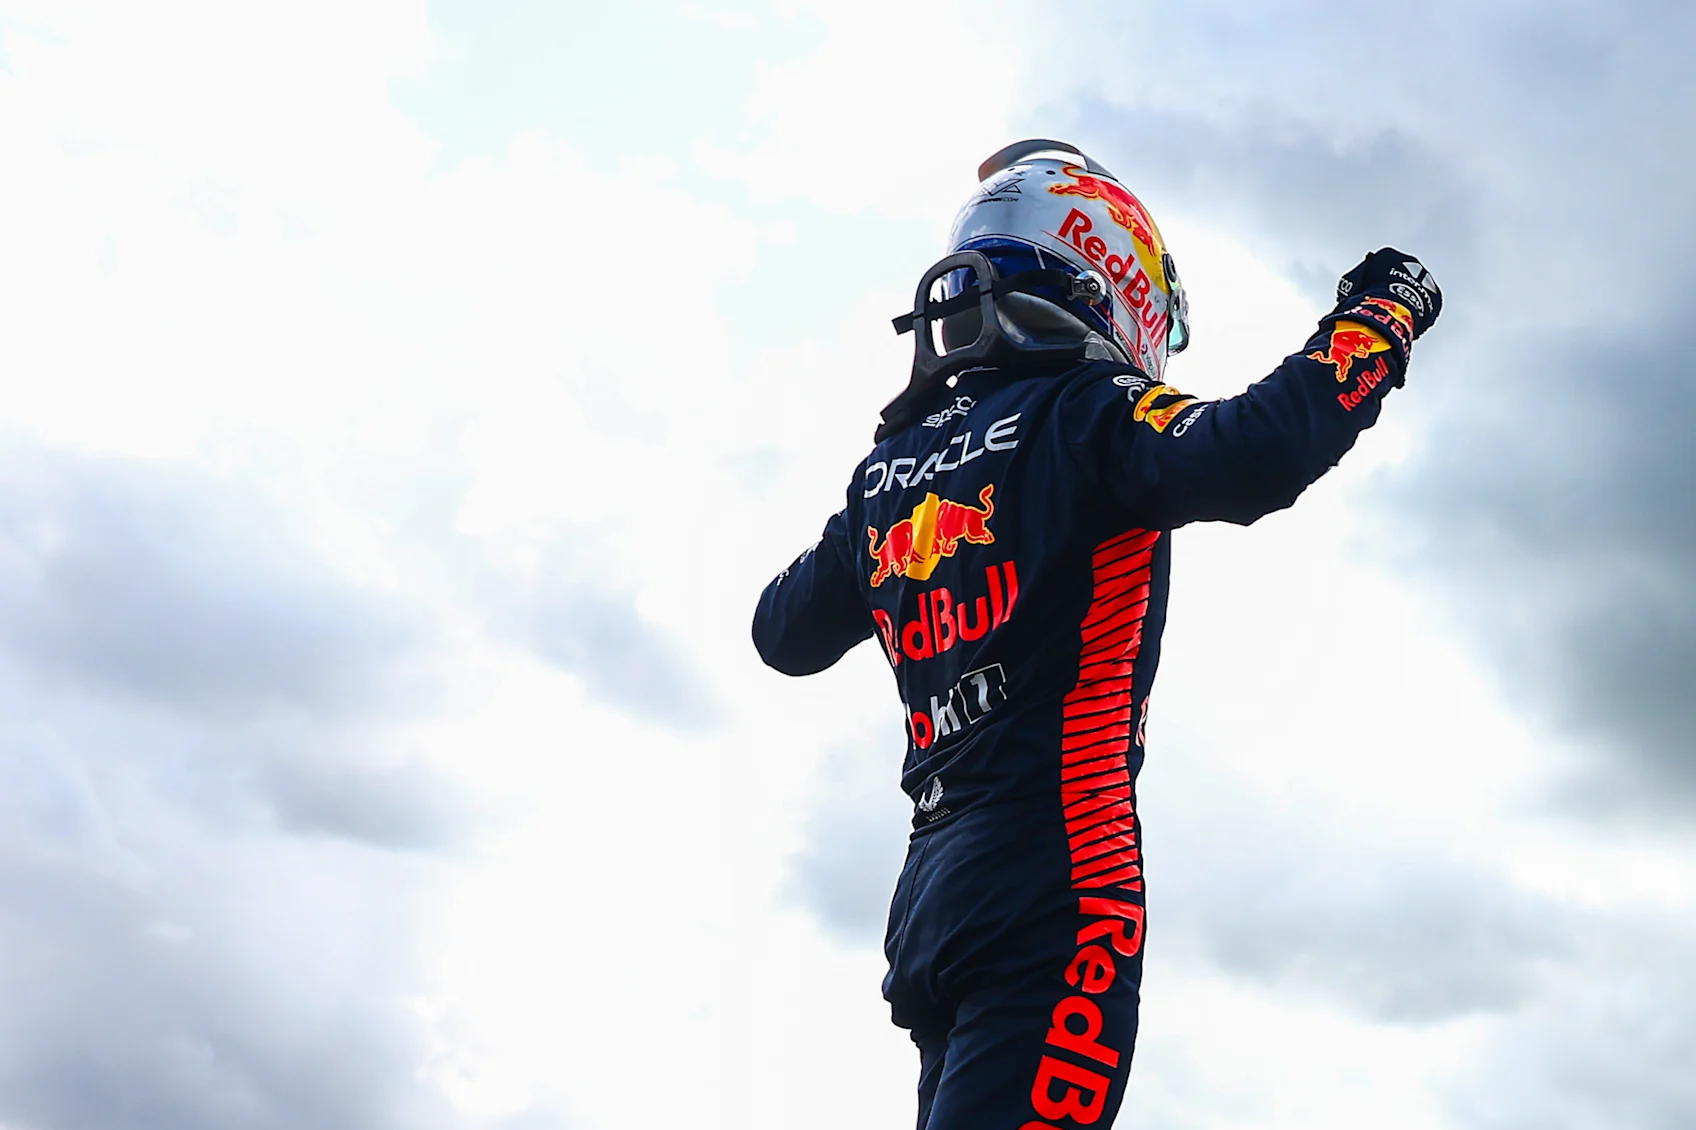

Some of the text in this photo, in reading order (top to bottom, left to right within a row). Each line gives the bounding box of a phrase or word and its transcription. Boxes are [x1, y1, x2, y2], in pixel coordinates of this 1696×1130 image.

[1337, 356, 1390, 412] RedBull
[864, 412, 1022, 499] ORACLE
[872, 560, 1019, 667] RdBull
